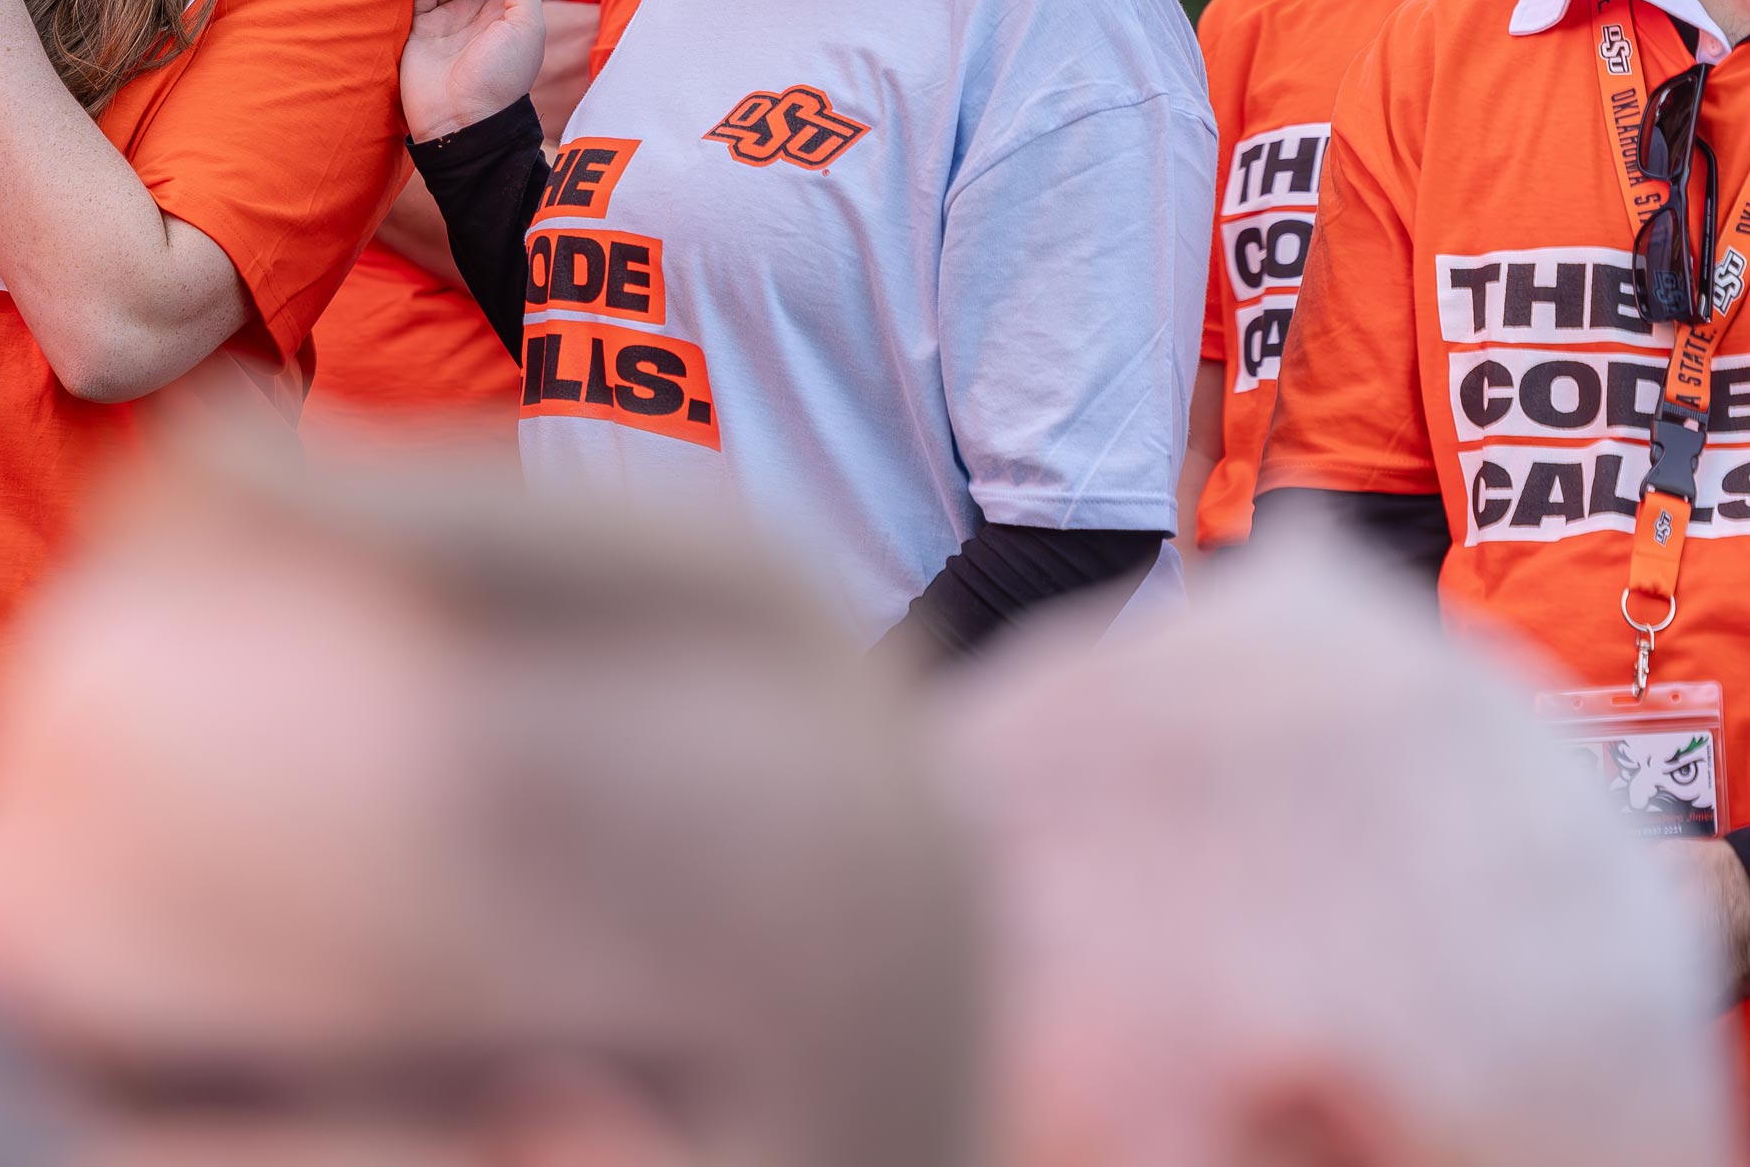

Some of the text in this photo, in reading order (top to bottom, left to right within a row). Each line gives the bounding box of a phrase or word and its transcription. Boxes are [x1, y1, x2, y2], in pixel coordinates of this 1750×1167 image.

[1599, 24, 1632, 75] OSU
[703, 85, 871, 170] OSU
[537, 149, 619, 212] HE
[1239, 137, 1330, 206] TH
[526, 235, 650, 313] ODE
[1235, 219, 1315, 288] CO
[1711, 246, 1747, 317] OSU
[1450, 263, 1654, 336] THE
